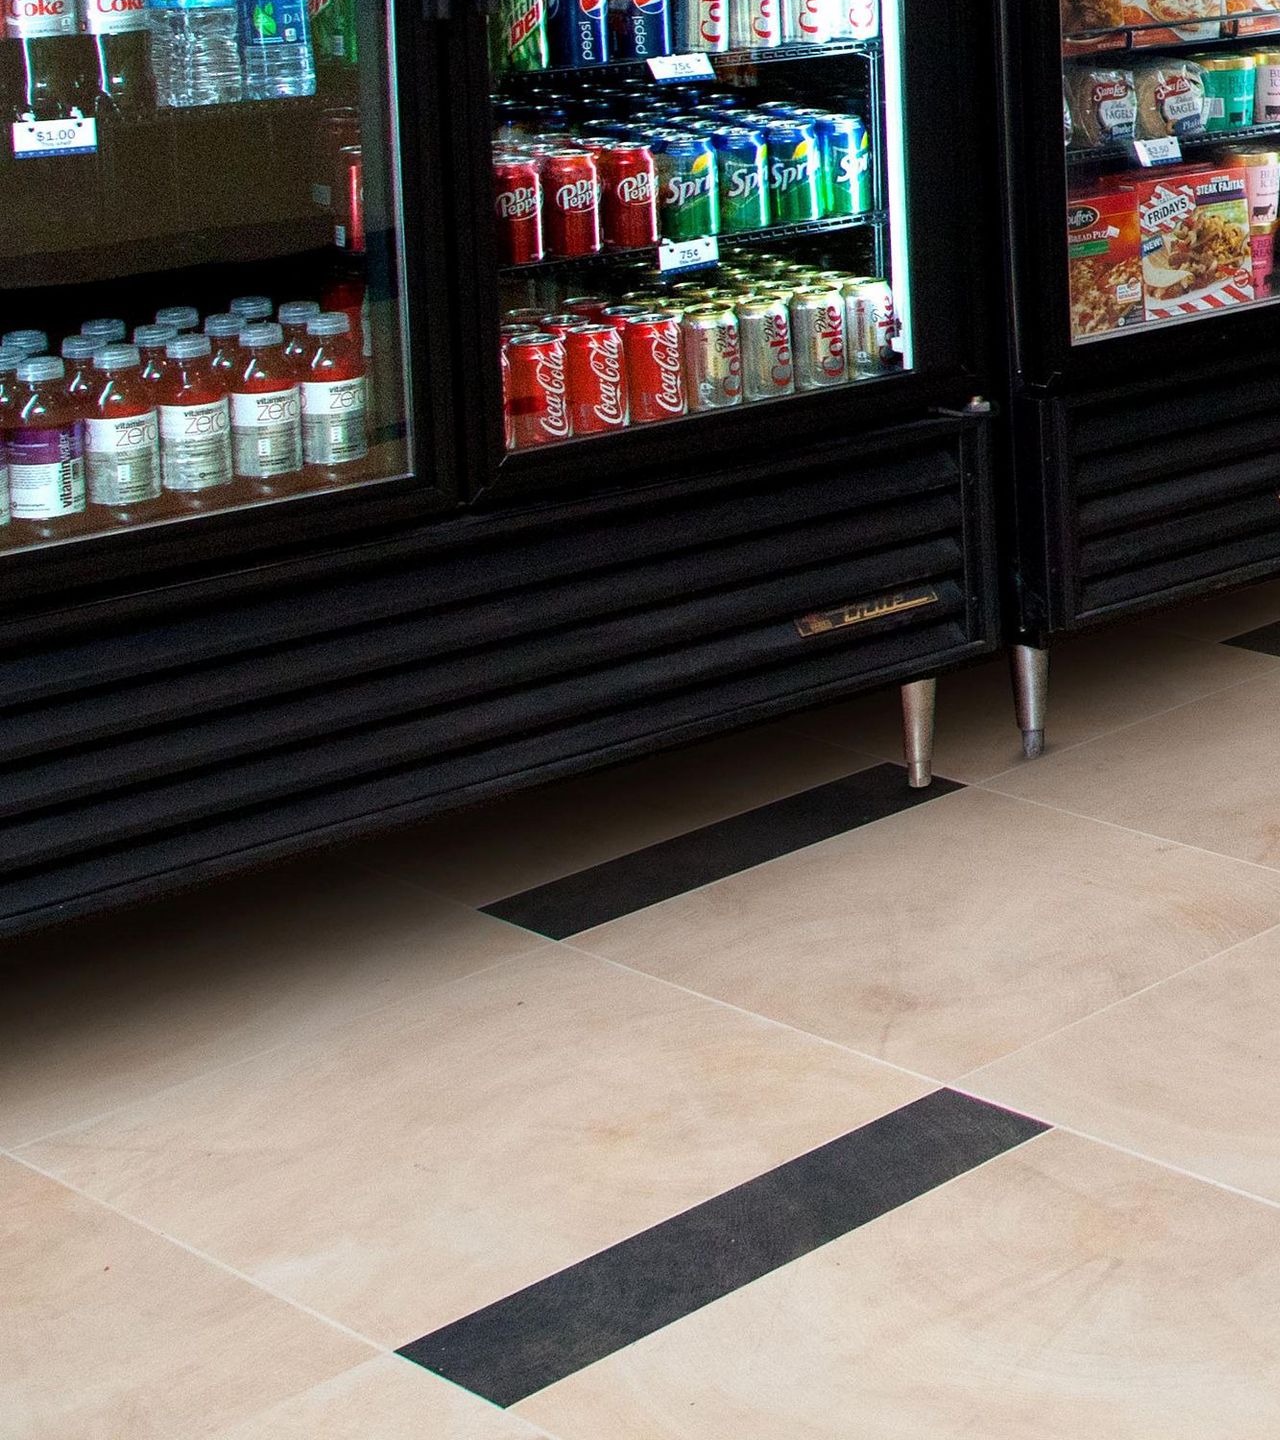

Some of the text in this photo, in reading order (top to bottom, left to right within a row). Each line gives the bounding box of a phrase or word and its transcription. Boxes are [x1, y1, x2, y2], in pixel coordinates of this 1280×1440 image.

[579, 21, 596, 61] pepsi
[632, 16, 649, 55] pepsi
[37, 128, 76, 142] $1.00
[1196, 182, 1218, 196] STEAK
[655, 322, 685, 413] Coca-Cola
[769, 314, 793, 387] Coke
[821, 304, 844, 378] Coke
[592, 329, 625, 426] Coca-Cola
